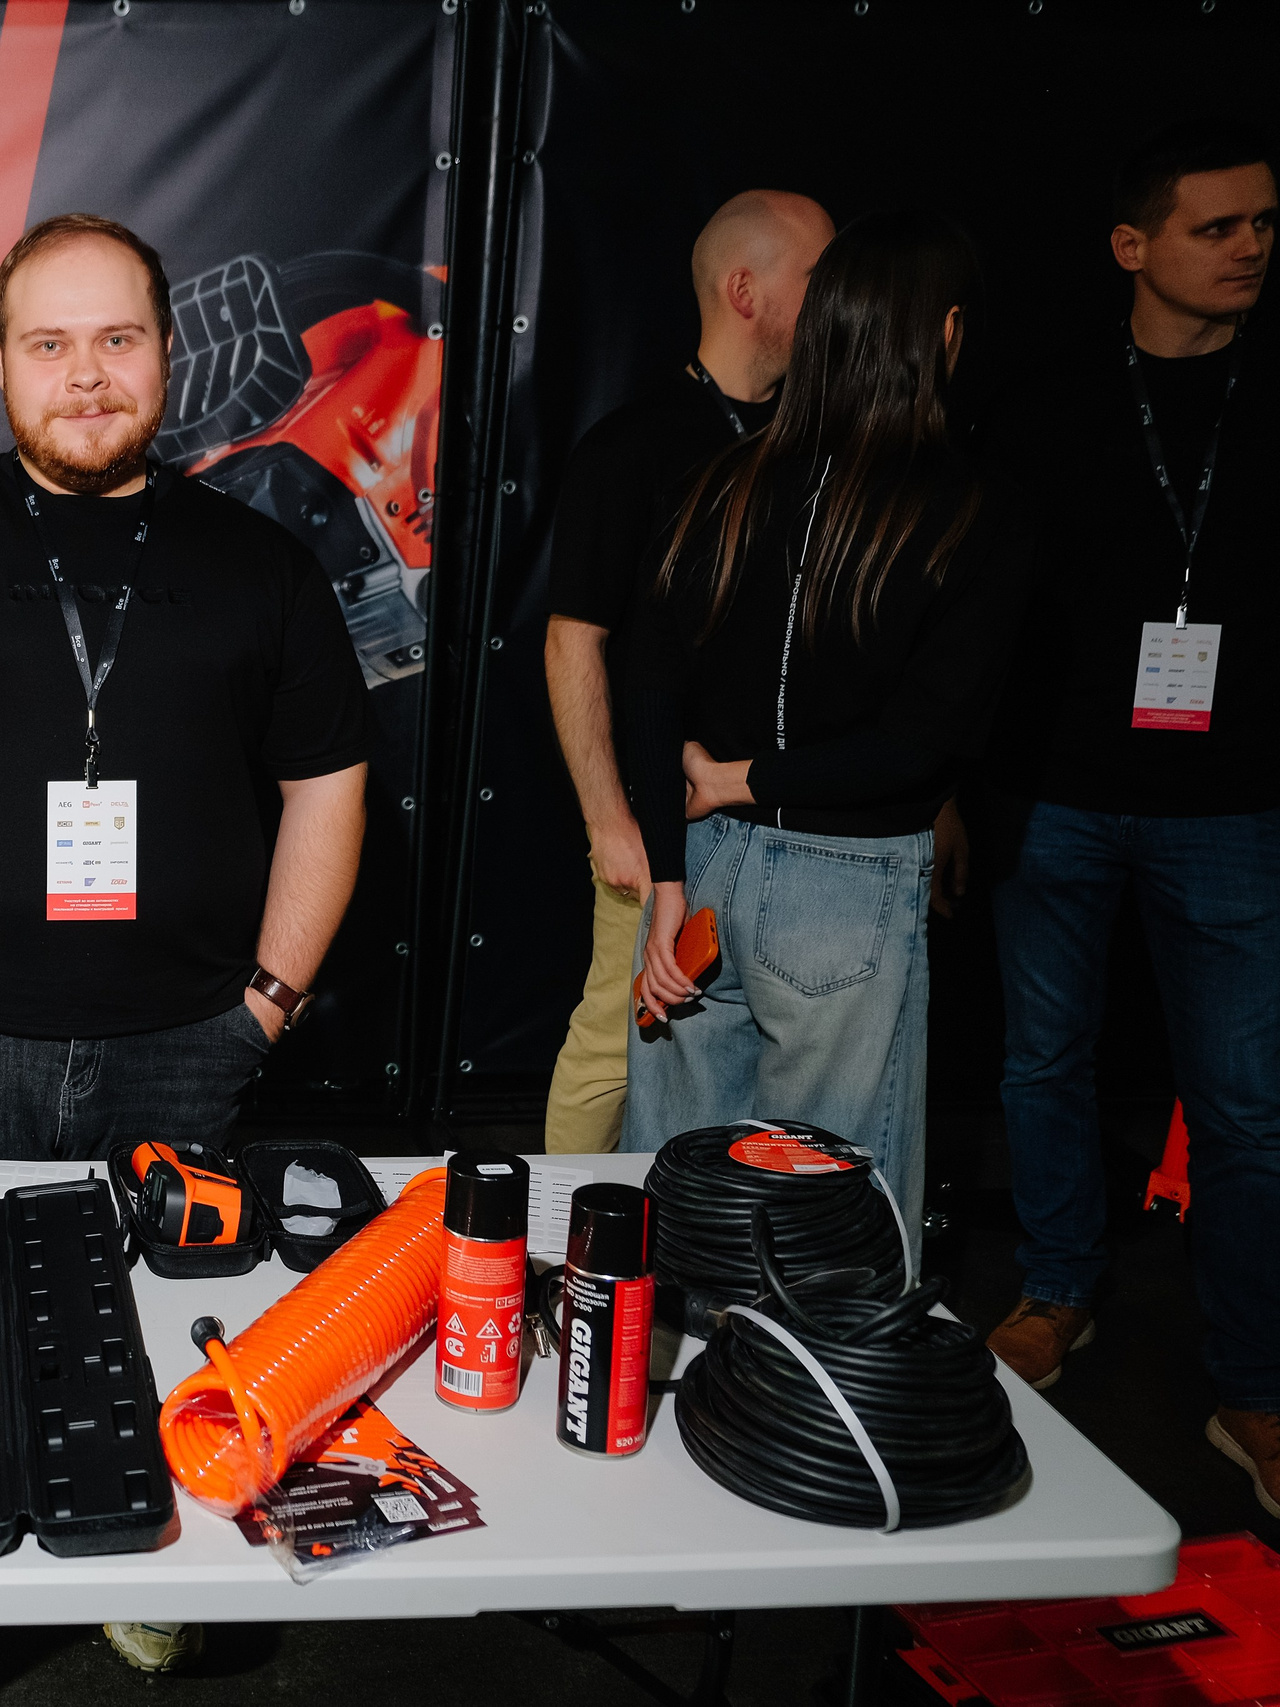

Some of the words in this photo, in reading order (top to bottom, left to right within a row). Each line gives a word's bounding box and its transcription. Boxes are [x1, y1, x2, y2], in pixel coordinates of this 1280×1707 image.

[780, 573, 802, 676] ПРОФЕССИОНАЛЬНО
[777, 684, 786, 731] НАДЕЖНО
[566, 1318, 592, 1444] GIGANT
[616, 1435, 634, 1448] 520
[1113, 1618, 1209, 1643] GIGANT
